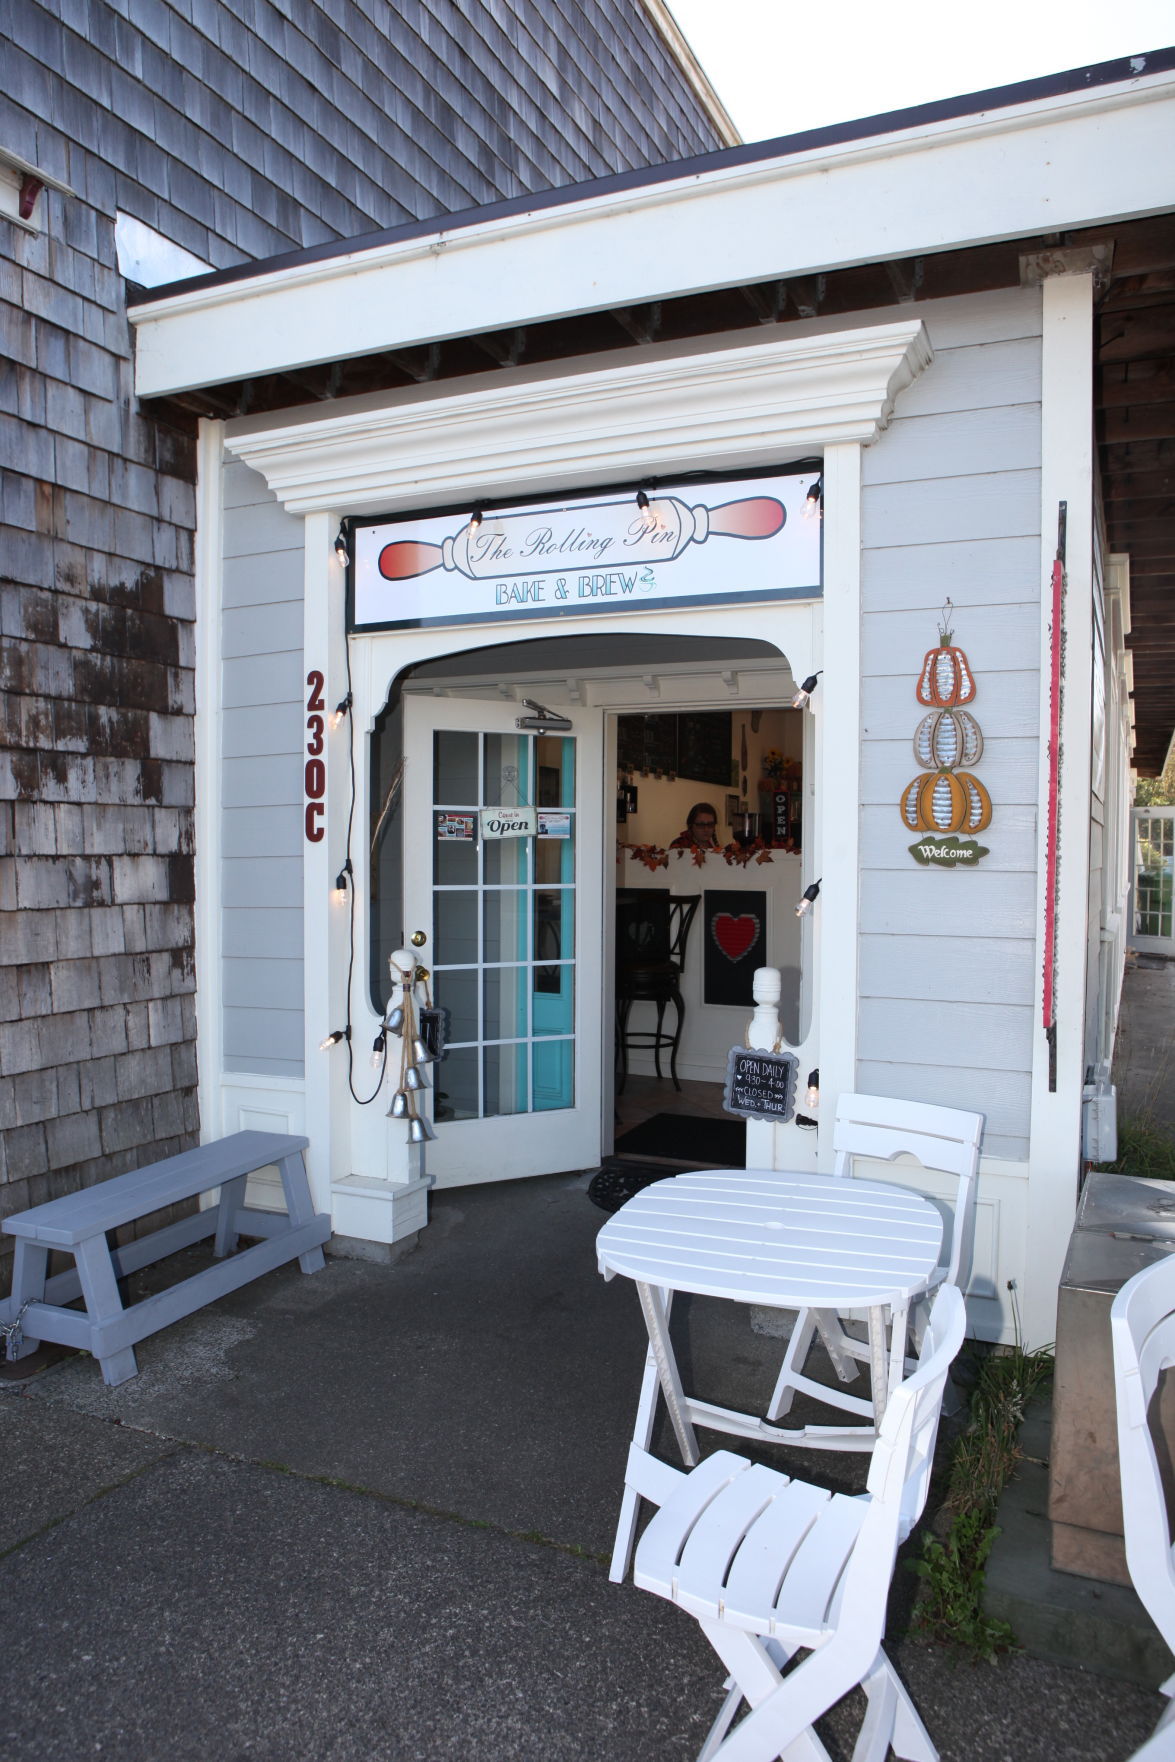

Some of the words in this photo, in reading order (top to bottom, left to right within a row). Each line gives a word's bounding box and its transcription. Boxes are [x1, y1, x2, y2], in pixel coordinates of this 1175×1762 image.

[469, 533, 514, 563] The
[520, 527, 615, 560] Rolling
[623, 516, 676, 546] Pin
[495, 579, 546, 606] BAKE
[554, 578, 570, 601] &
[578, 570, 640, 599] BREW
[305, 670, 325, 842] 230C
[487, 819, 529, 835] Open
[775, 794, 786, 836] OPEN
[917, 845, 974, 860] Welcome
[740, 1059, 760, 1074] OPEN
[762, 1063, 785, 1078] DAILY
[743, 1086, 773, 1098] CLOSED
